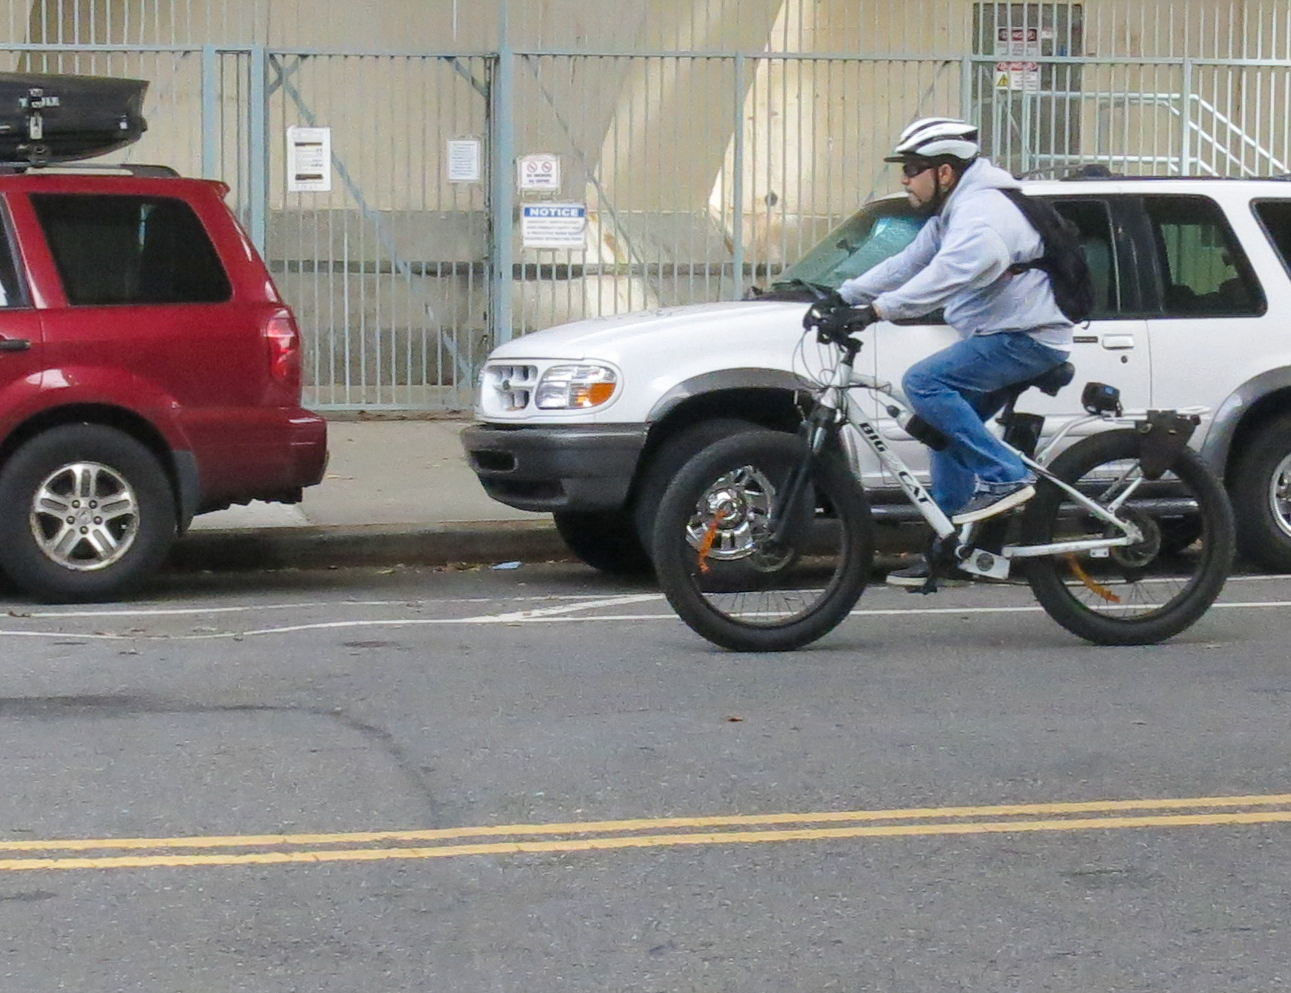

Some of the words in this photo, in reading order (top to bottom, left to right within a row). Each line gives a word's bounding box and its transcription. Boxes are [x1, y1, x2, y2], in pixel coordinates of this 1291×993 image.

[529, 207, 579, 217] NOTICE
[859, 423, 888, 452] BIG
[899, 471, 933, 505] CAT
